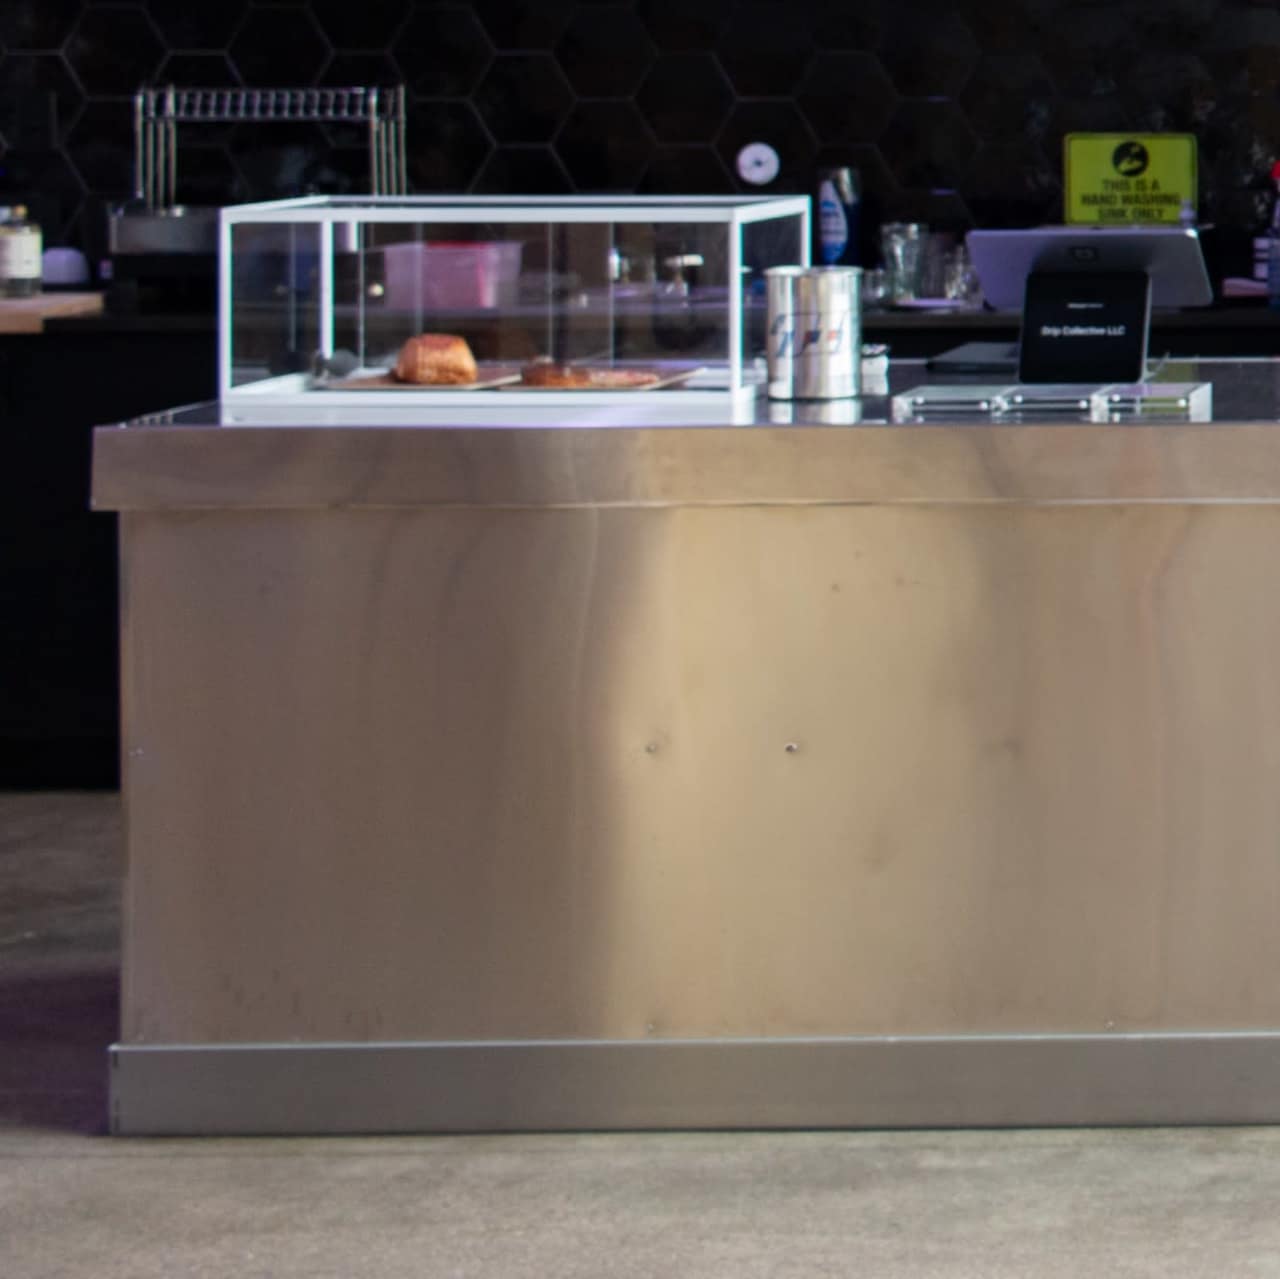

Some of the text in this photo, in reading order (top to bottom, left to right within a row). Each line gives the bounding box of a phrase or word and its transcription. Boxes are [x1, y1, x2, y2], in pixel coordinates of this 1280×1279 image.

[1102, 179, 1160, 191] THIS IS A
[1082, 194, 1180, 206] HAND WASHING
[1098, 209, 1164, 220] SINK ONLY
[1041, 325, 1125, 337] Drip Collective LLC
